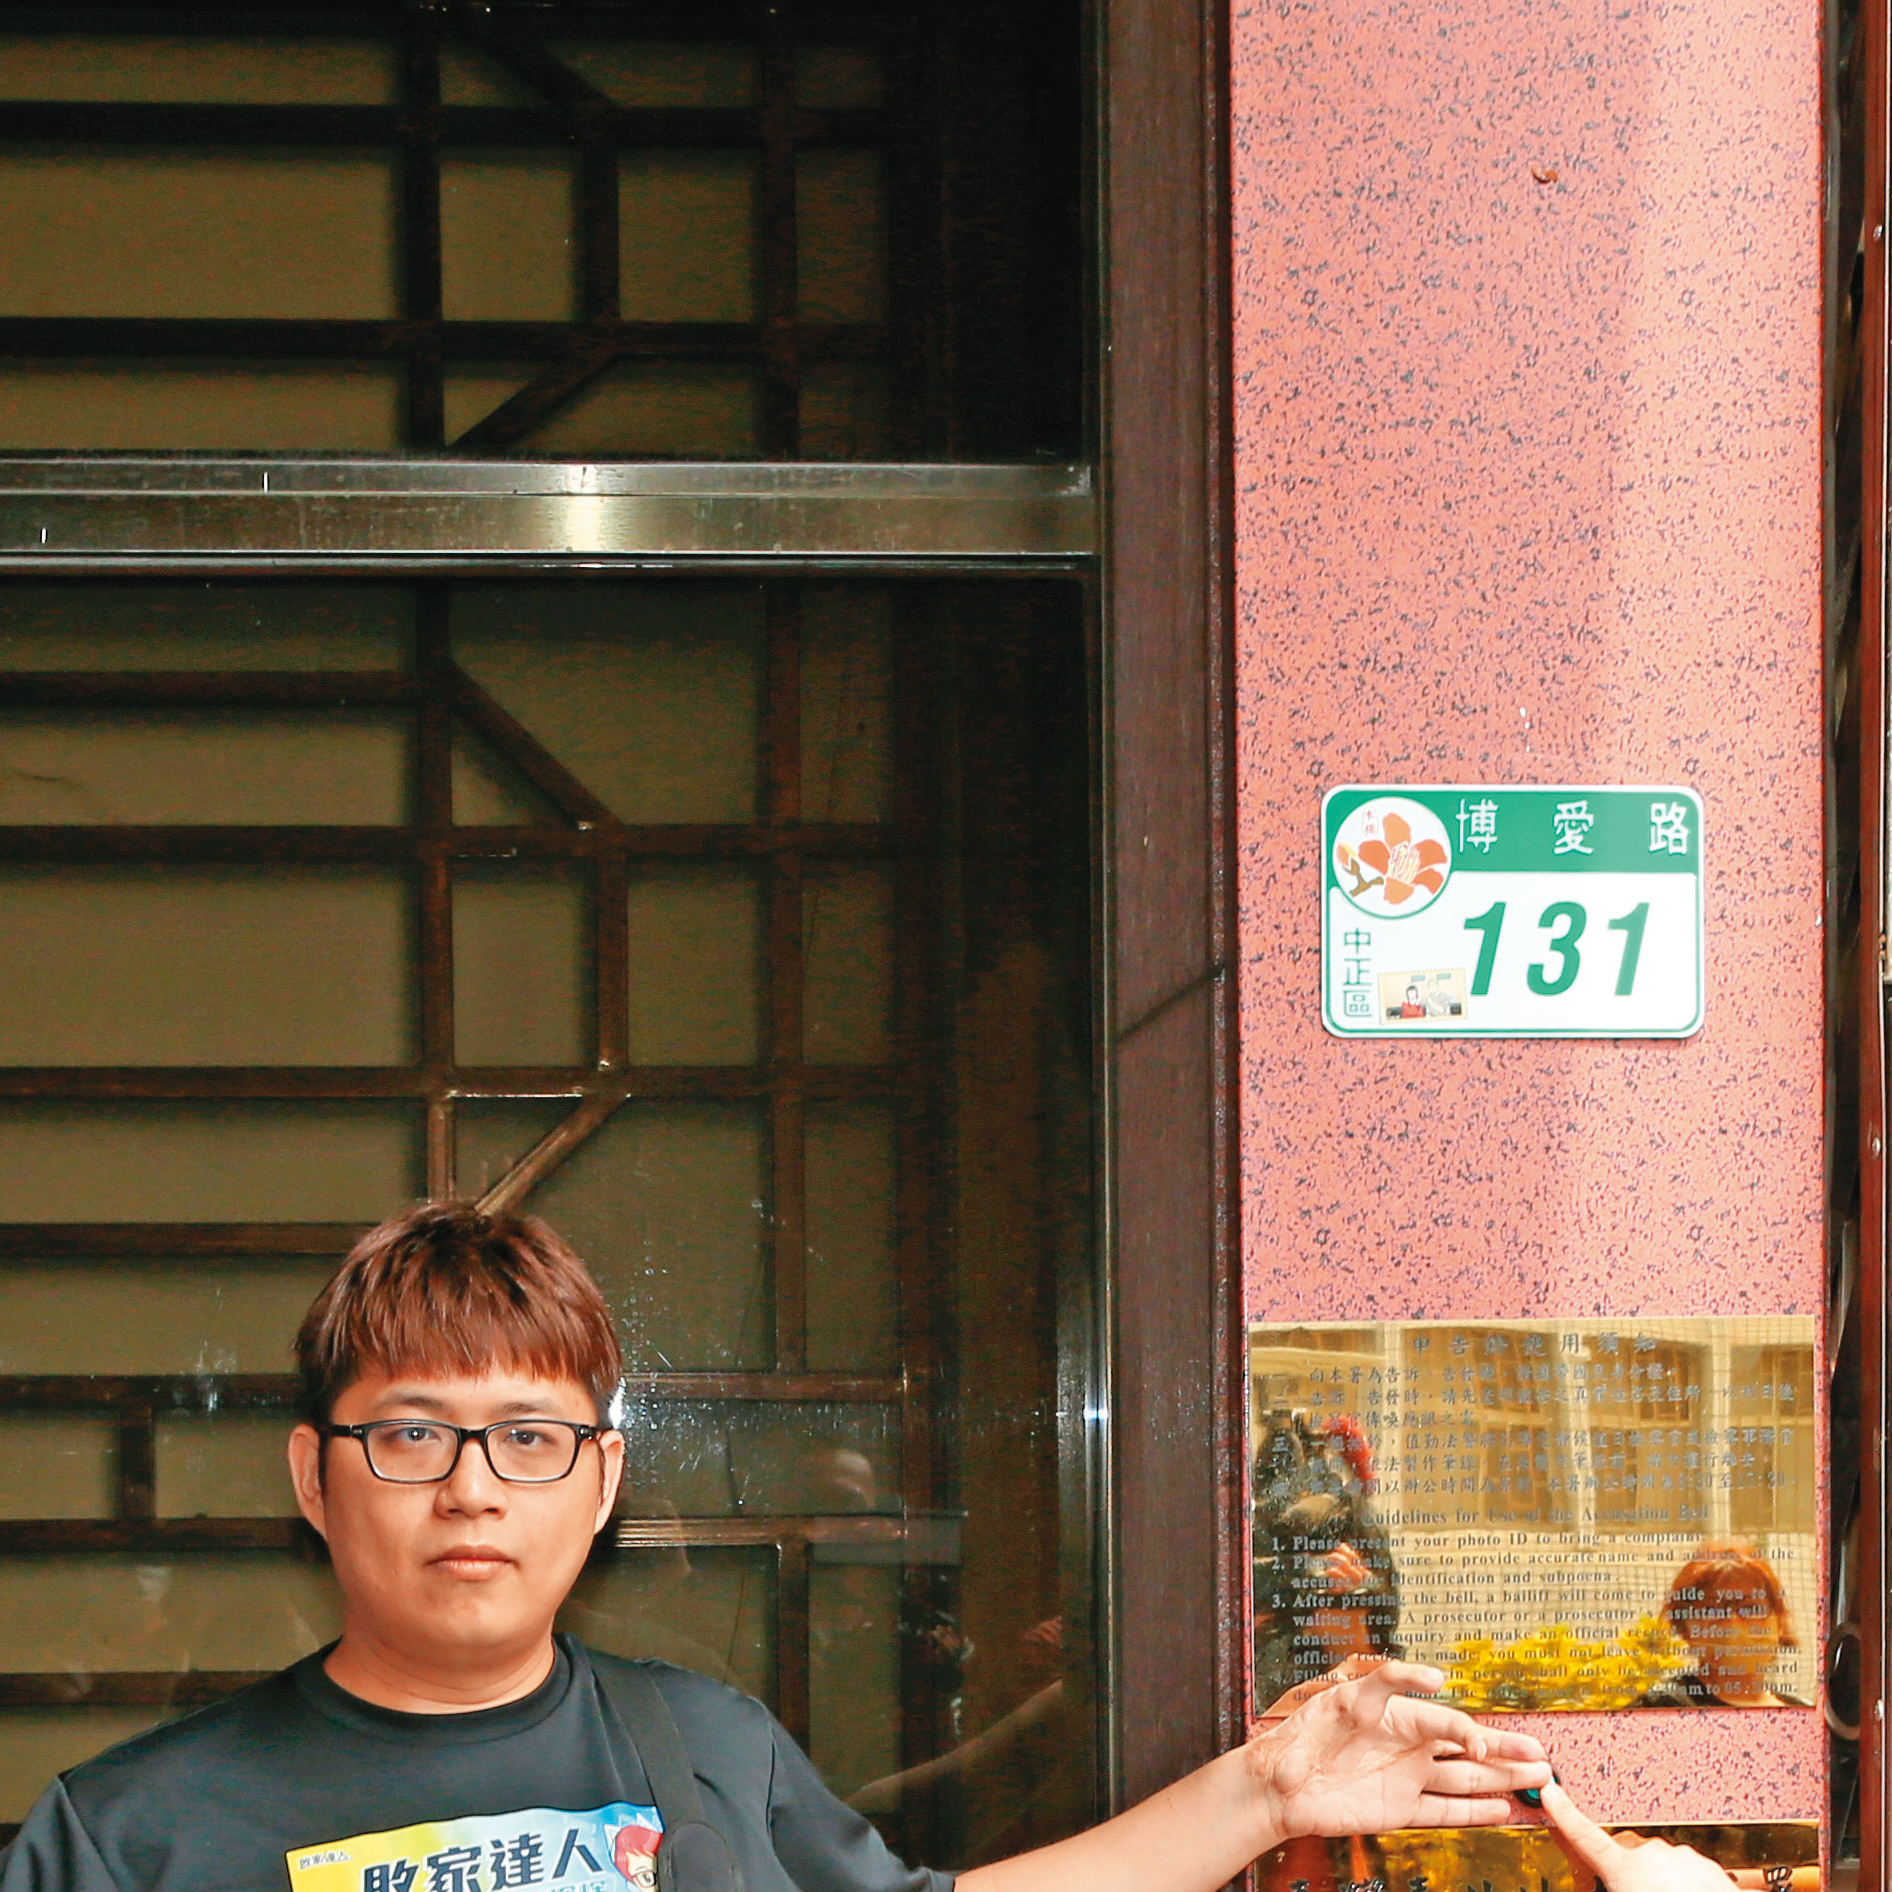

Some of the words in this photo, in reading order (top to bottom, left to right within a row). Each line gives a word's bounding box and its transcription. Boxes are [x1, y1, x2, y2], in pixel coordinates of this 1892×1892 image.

[1456, 798, 1690, 856] 博愛路
[1464, 901, 1651, 997] 131
[1343, 927, 1373, 1019] 中正區
[1361, 1508, 1447, 1527] Guidelines
[1456, 1508, 1479, 1523] for
[1272, 1537, 1286, 1551] 1.
[1293, 1535, 1341, 1551] Please
[1414, 1535, 1450, 1551] your
[1457, 1532, 1501, 1550] photo
[1509, 1532, 1528, 1546] ID
[1536, 1533, 1551, 1545] to
[1559, 1531, 1601, 1547] bring
[1272, 1555, 1286, 1570] 2.
[1399, 1555, 1431, 1567] sure
[1439, 1553, 1454, 1566] to
[1462, 1551, 1521, 1569] provide
[1646, 1549, 1675, 1562] and
[1770, 1547, 1795, 1561] the
[1390, 1569, 1496, 1586] identification
[1502, 1569, 1532, 1584] and
[1272, 1594, 1287, 1609] 3.
[1293, 1593, 1334, 1608] After
[1341, 1590, 1406, 1610] pressing
[1414, 1590, 1438, 1605] the
[1558, 1588, 1586, 1602] will
[1593, 1589, 1634, 1602] come
[1641, 1588, 1656, 1601] to
[1715, 1587, 1744, 1604] you
[1751, 1587, 1767, 1600] to
[1293, 1611, 1352, 1630] waiting
[1404, 1610, 1416, 1624] A
[1423, 1608, 1507, 1627] prosecutor
[1513, 1609, 1531, 1622] or
[1665, 1603, 1732, 1621] assistant
[1293, 1629, 1356, 1646] conduct
[1388, 1628, 1446, 1647] inquiry
[1452, 1627, 1482, 1643] and
[1490, 1627, 1532, 1642] make
[1538, 1628, 1558, 1641] an
[1564, 1625, 1620, 1640] official
[1414, 1648, 1427, 1662] is
[1488, 1648, 1516, 1664] you
[1524, 1646, 1560, 1660] must
[1569, 1645, 1593, 1658] not
[1600, 1644, 1642, 1658] leave
